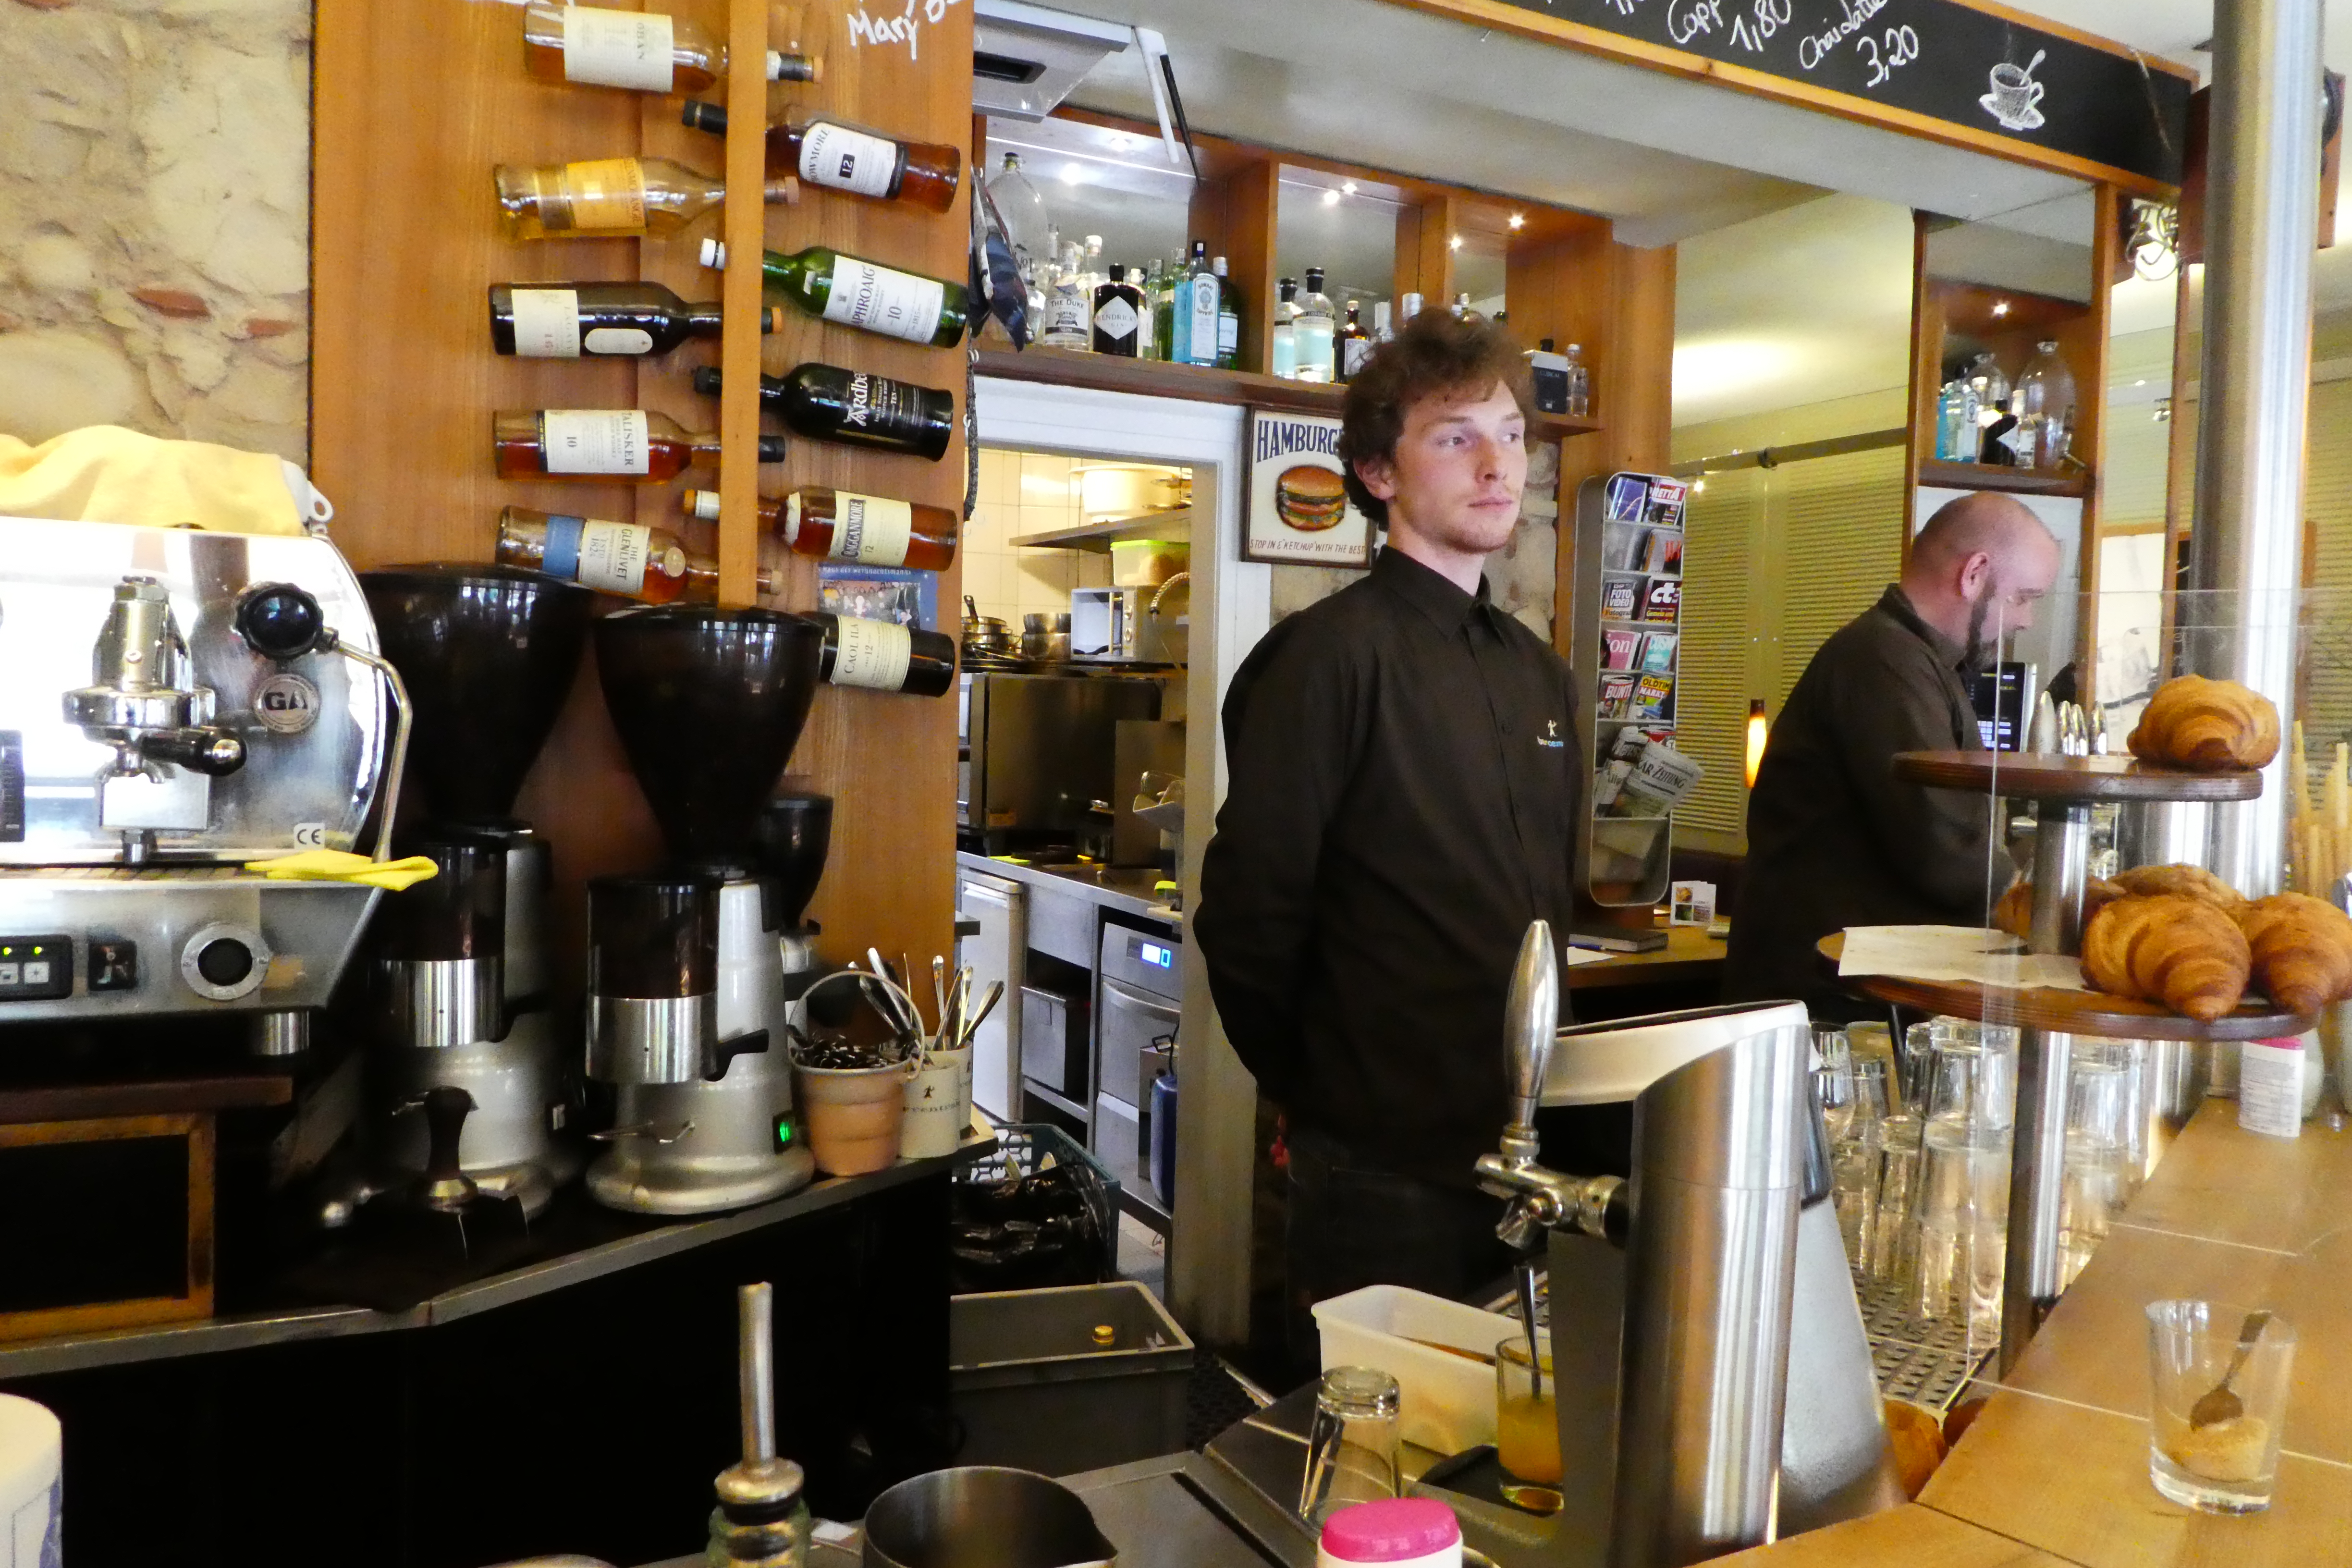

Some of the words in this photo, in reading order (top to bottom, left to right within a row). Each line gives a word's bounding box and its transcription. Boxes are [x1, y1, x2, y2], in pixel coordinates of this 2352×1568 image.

[636, 22, 645, 60] OBAN
[846, 9, 919, 61] Mary
[1857, 24, 1919, 87] 3,20
[842, 159, 853, 173] 12
[851, 266, 875, 325] APHROAIG
[1066, 299, 1085, 309] DUKE
[887, 305, 902, 320] 10
[844, 373, 870, 427] Ardbe
[566, 436, 577, 448] 10
[622, 412, 634, 466] TALISKER
[1256, 419, 1344, 463] HAMBURG
[616, 528, 633, 580] GLENLIVET
[630, 546, 638, 562] THE
[1249, 539, 1267, 549] STOP
[1267, 540, 1276, 550] IN
[1315, 543, 1333, 552] WITH
[1334, 544, 1347, 553] THE
[1611, 589, 1632, 599] FOTO
[1609, 598, 1630, 607] VIDEO
[850, 624, 859, 638] ILA
[865, 645, 873, 655] 12
[844, 643, 859, 674] CAOL
[1642, 677, 1671, 689] OLDTIM
[1638, 761, 1654, 776] AR
[1652, 765, 1687, 789] ZEITUNG
